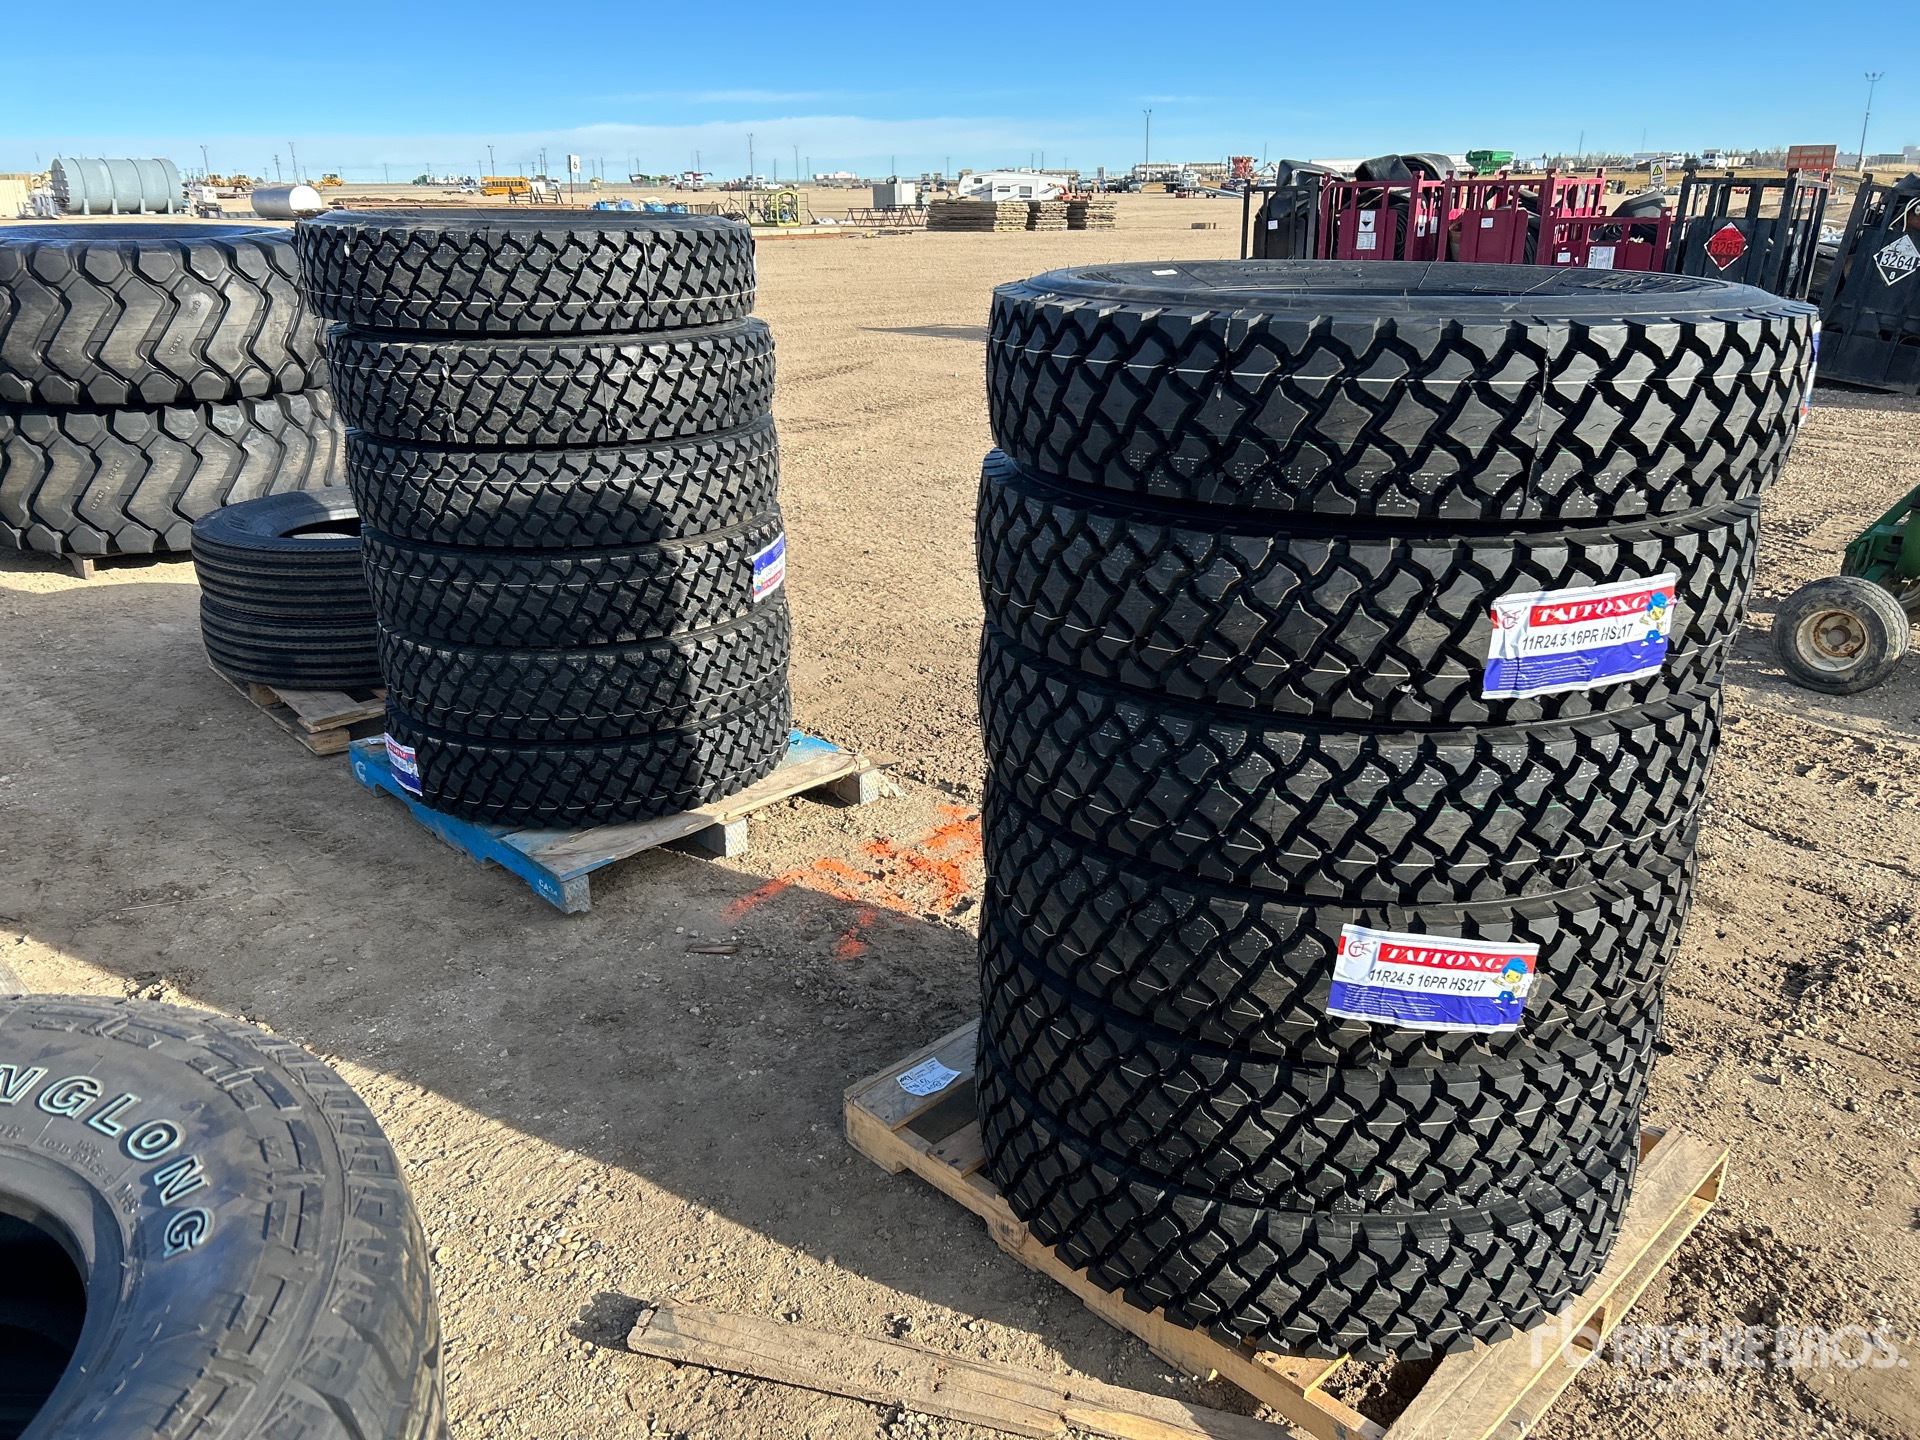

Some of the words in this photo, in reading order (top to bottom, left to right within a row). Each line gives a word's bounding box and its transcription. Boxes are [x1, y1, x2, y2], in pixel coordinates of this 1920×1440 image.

[573, 160, 578, 170] 6
[1711, 241, 1741, 255] 3265
[1720, 257, 1727, 265] 8
[1881, 253, 1914, 270] 3264
[1889, 271, 1897, 280] 8
[1537, 594, 1648, 623] TAITONG
[1522, 634, 1567, 651] 11R24.5
[1570, 628, 1599, 646] 16PR
[1385, 947, 1504, 970] TAITONG
[1369, 968, 1415, 986] 11R24.5
[1417, 976, 1449, 990] 16PR
[1449, 977, 1487, 992] HS217
